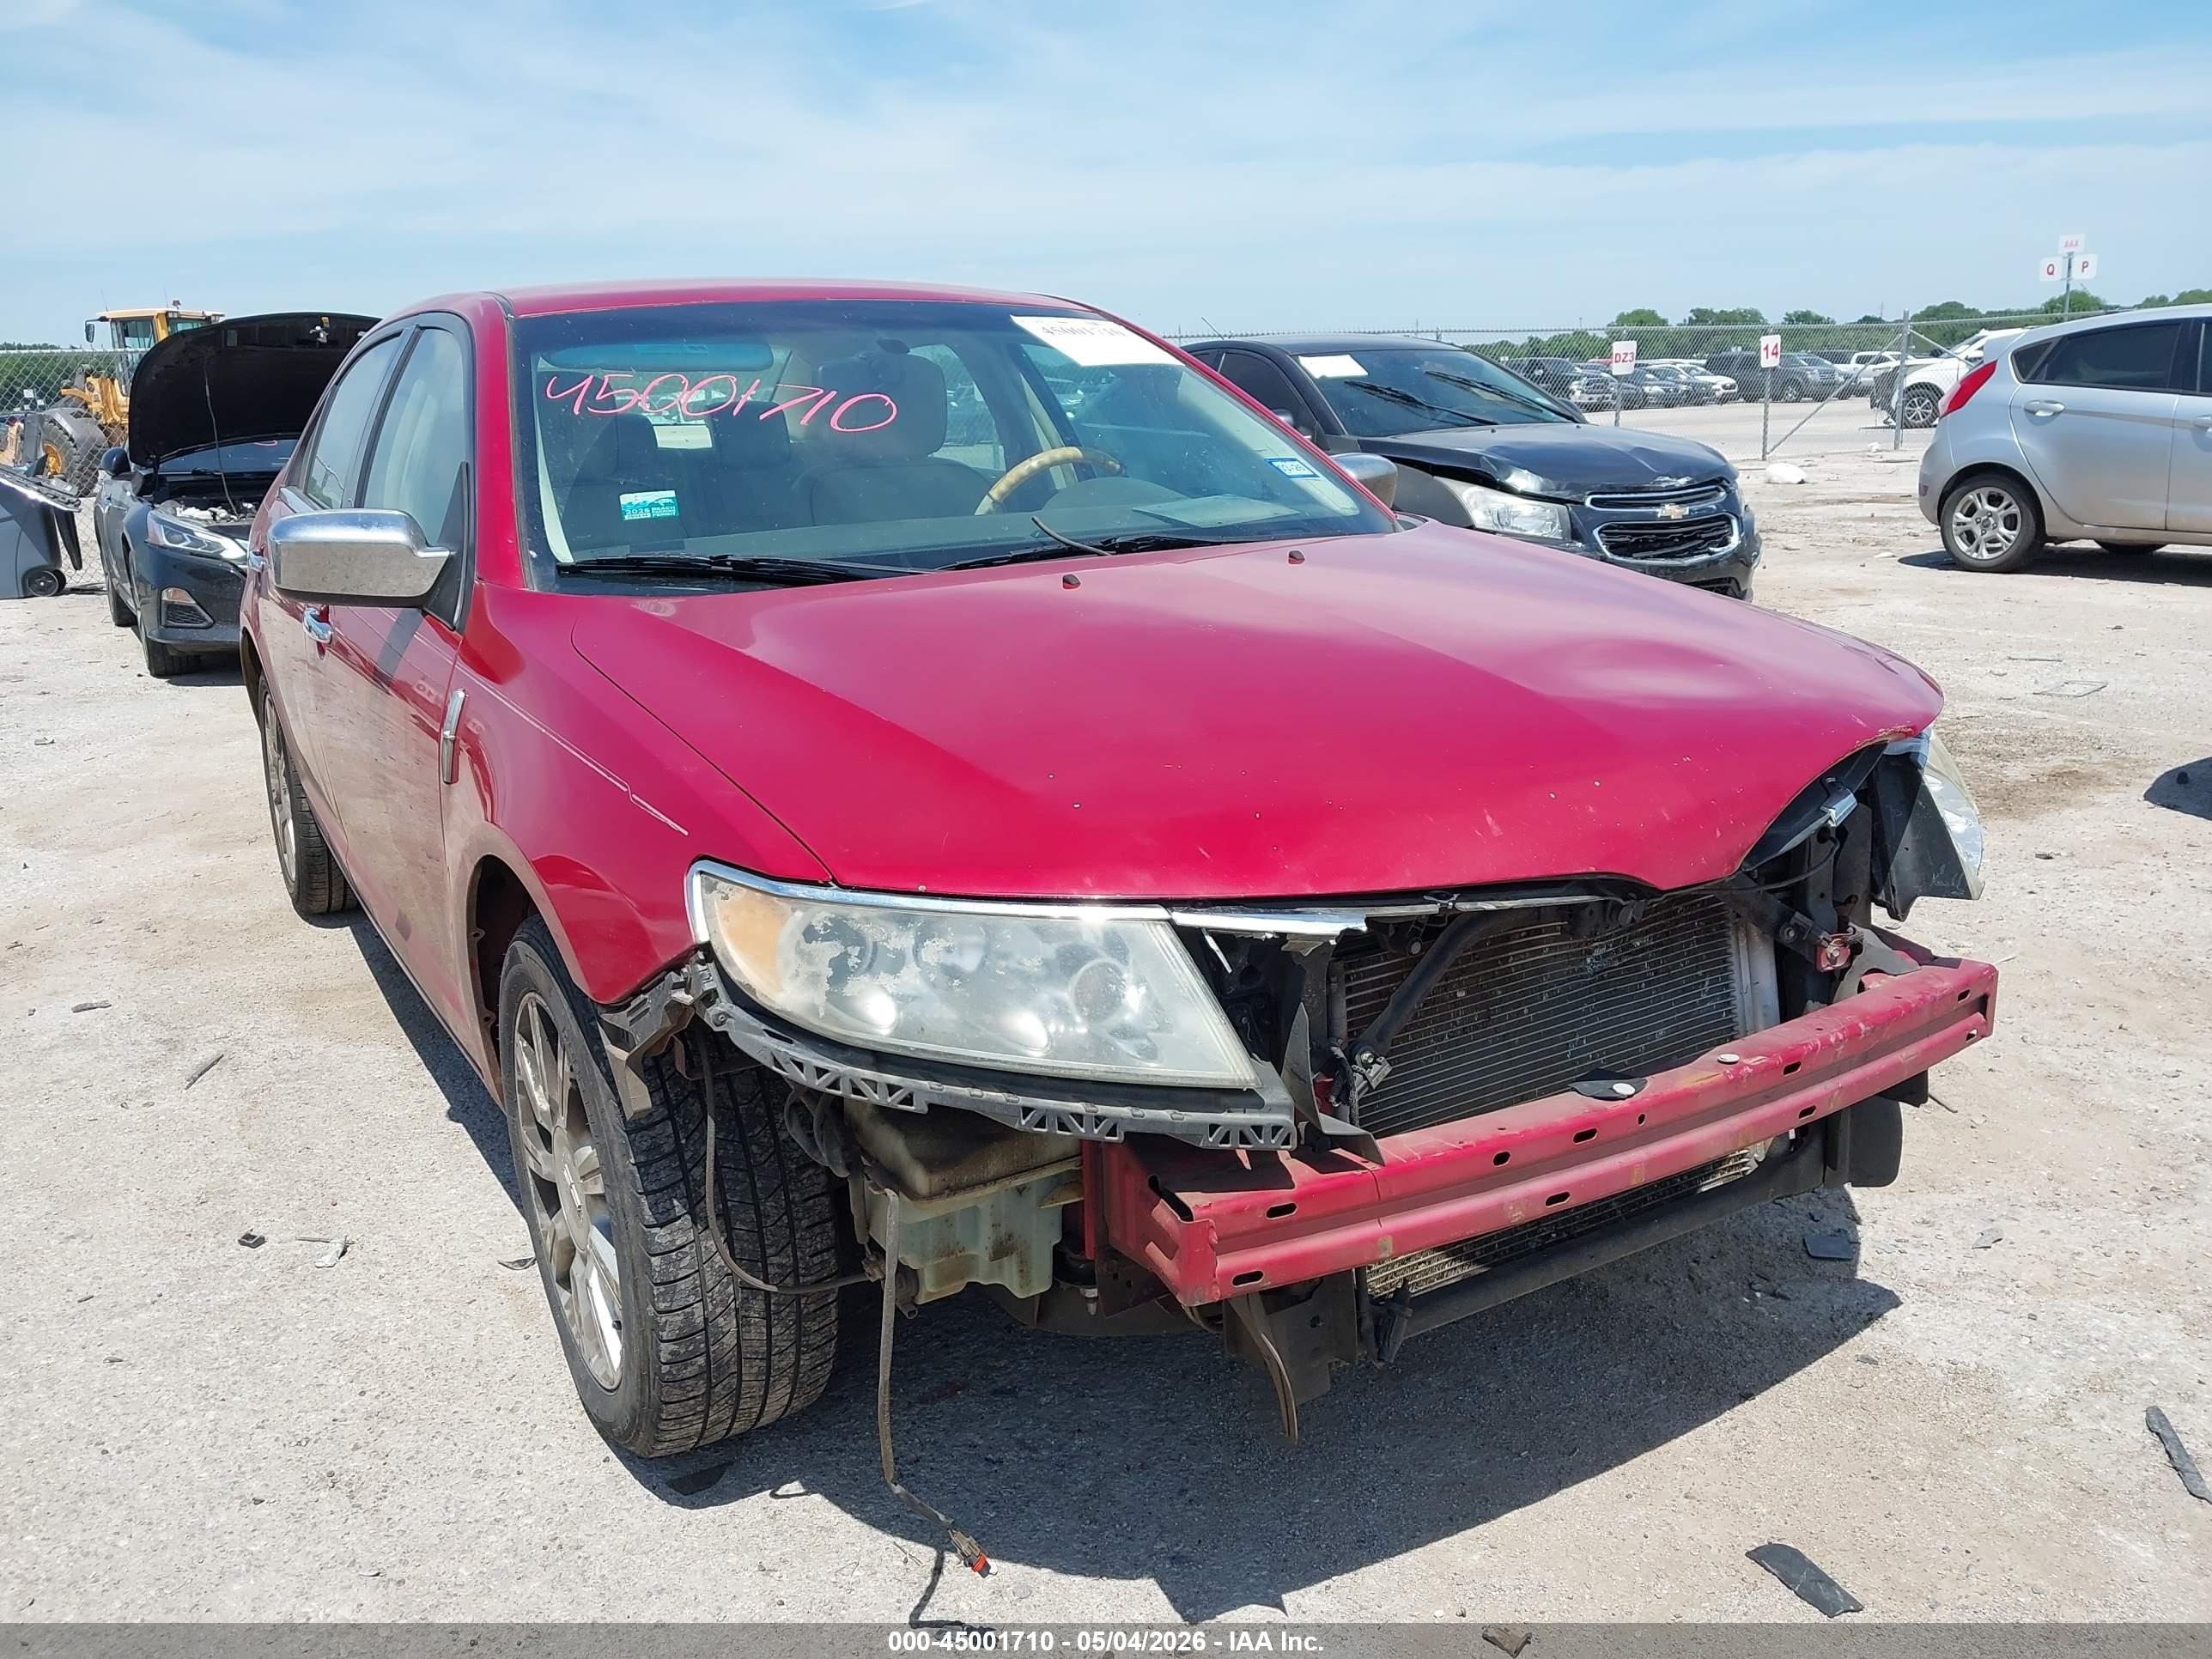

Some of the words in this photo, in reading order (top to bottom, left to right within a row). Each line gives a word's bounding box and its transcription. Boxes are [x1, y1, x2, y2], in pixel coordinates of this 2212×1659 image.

[2046, 264, 2055, 276] Q
[2081, 260, 2089, 273] P
[1614, 352, 1635, 363] DZ3
[1763, 343, 1778, 359] 14
[546, 374, 897, 433] 45001710
